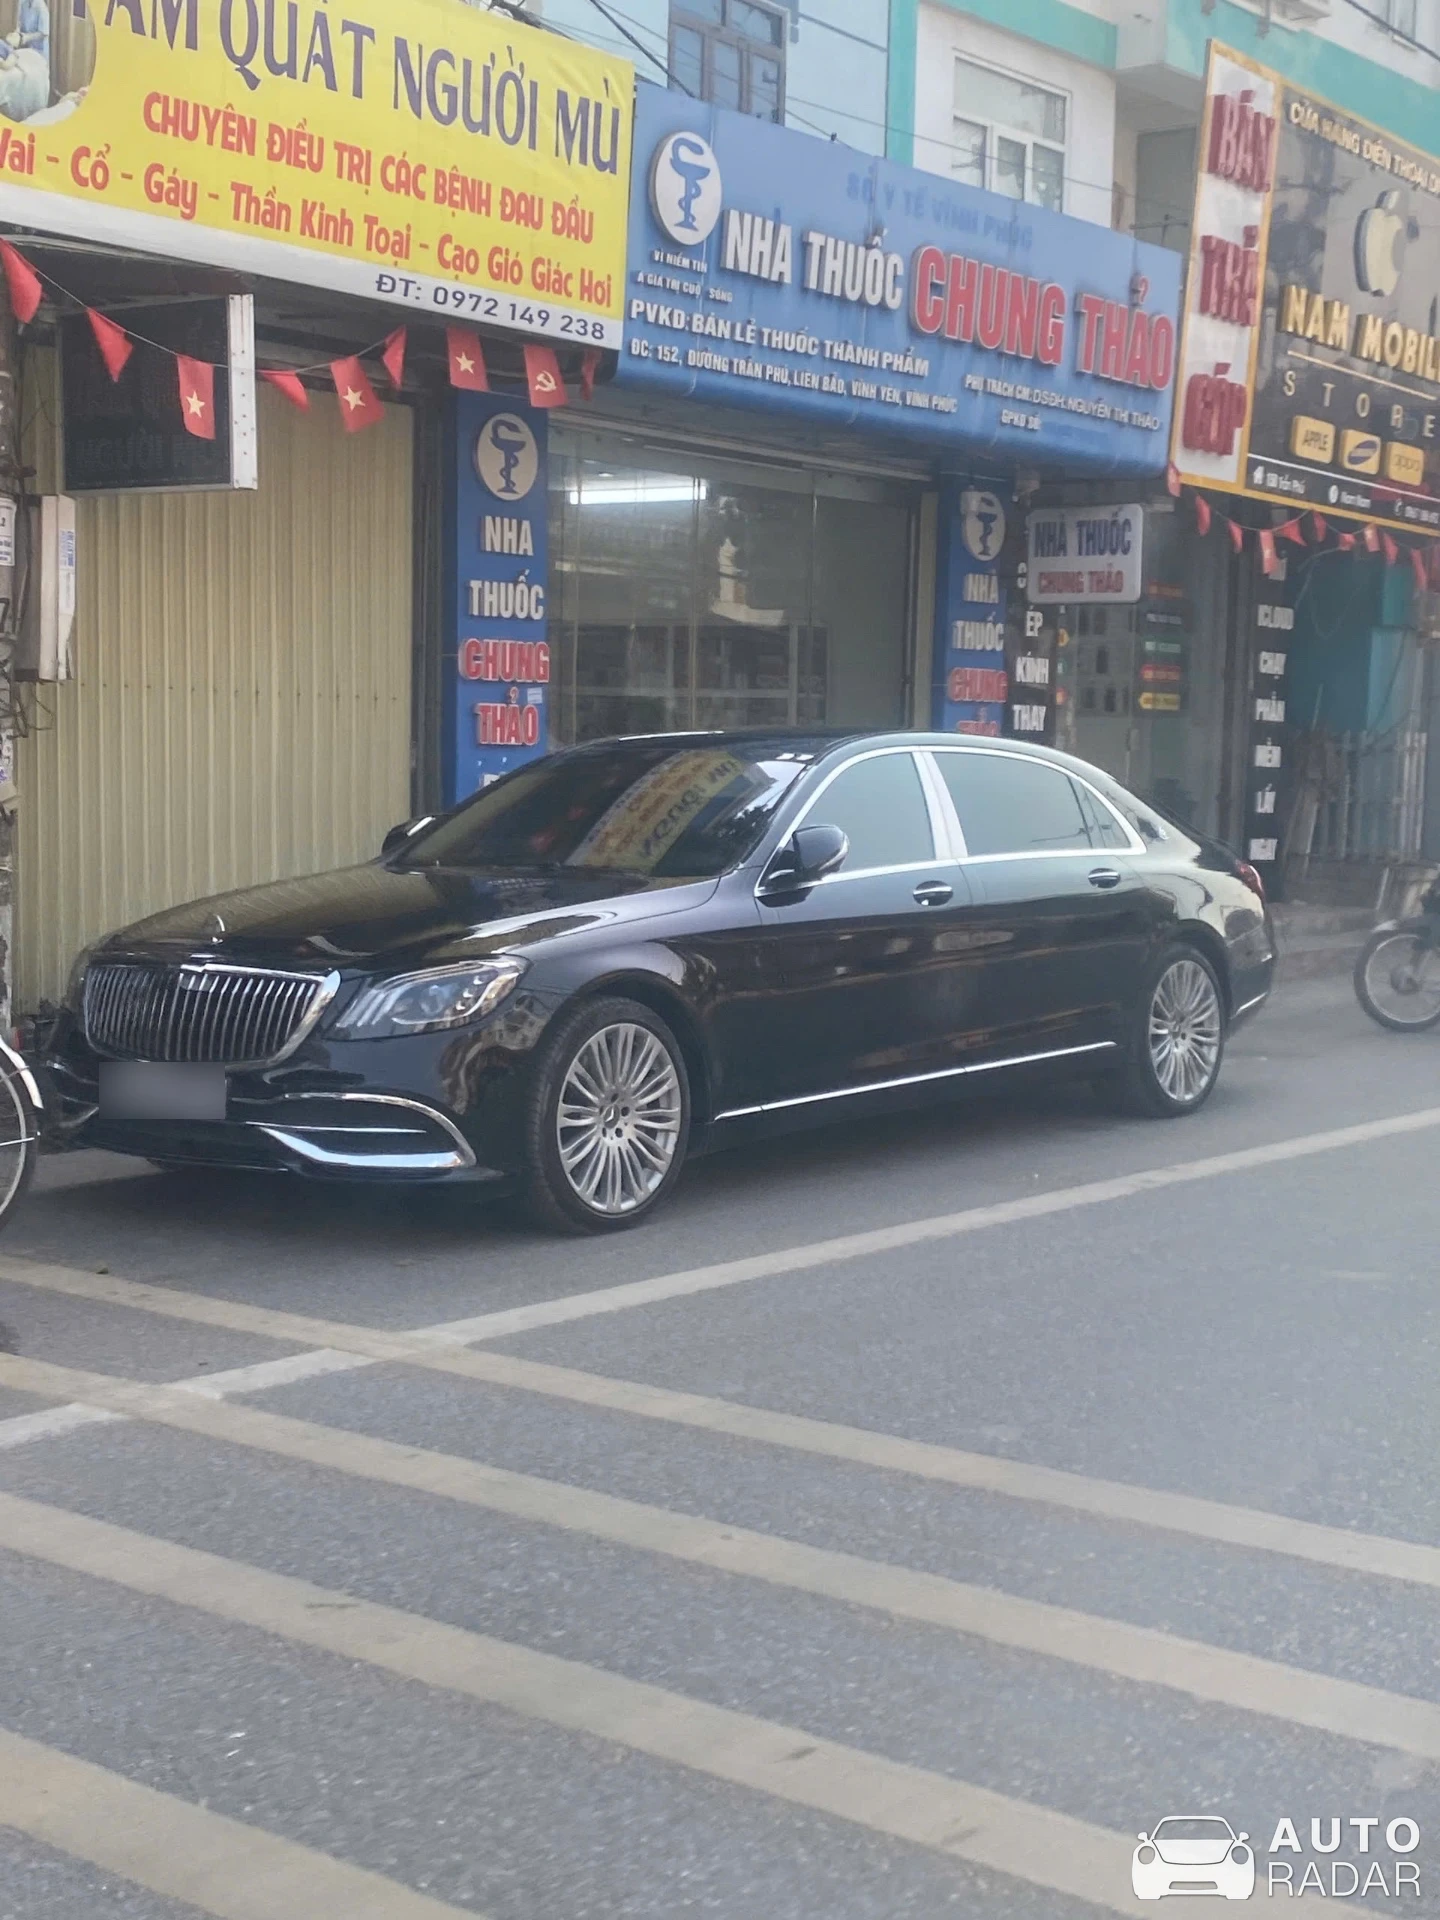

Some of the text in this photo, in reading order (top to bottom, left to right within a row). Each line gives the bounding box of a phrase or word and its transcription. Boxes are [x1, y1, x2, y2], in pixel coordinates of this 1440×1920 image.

[393, 36, 538, 151] NGƯỜI
[555, 76, 621, 175] MÙ
[143, 91, 594, 244] CHUYÊN ĐIỀU TRỊ CÁC BỆNH ĐAU ĐẦU
[70, 143, 111, 192] Cổ
[143, 162, 198, 221] Gáy
[230, 180, 292, 233] Thần
[299, 198, 354, 247] Kinh
[363, 213, 412, 267] Toại
[437, 233, 480, 281] Cạo
[487, 246, 524, 286] Gió
[531, 256, 574, 298] Giác
[579, 267, 612, 308] Hơi
[375, 272, 605, 340] ĐT: 0972 149 238
[631, 299, 690, 331] PVKD:
[734, 317, 757, 345] LẺ
[762, 325, 820, 356] THUỐC
[823, 338, 880, 369] THÀNH
[804, 228, 904, 310] THUỐC
[911, 245, 1067, 366] CHUNG
[1076, 275, 1176, 392] THẢO
[1281, 284, 1350, 351] NAM
[657, 344, 683, 366] 152,
[1282, 370, 1437, 438] STORE
[469, 569, 545, 620] THUỐC
[459, 638, 550, 684] CHUNG
[953, 611, 1005, 652] THUỐC
[950, 667, 1009, 703] CHUNG
[1015, 651, 1050, 684] KÍNH
[474, 686, 540, 746] THẢO
[1012, 704, 1047, 732] THAY
